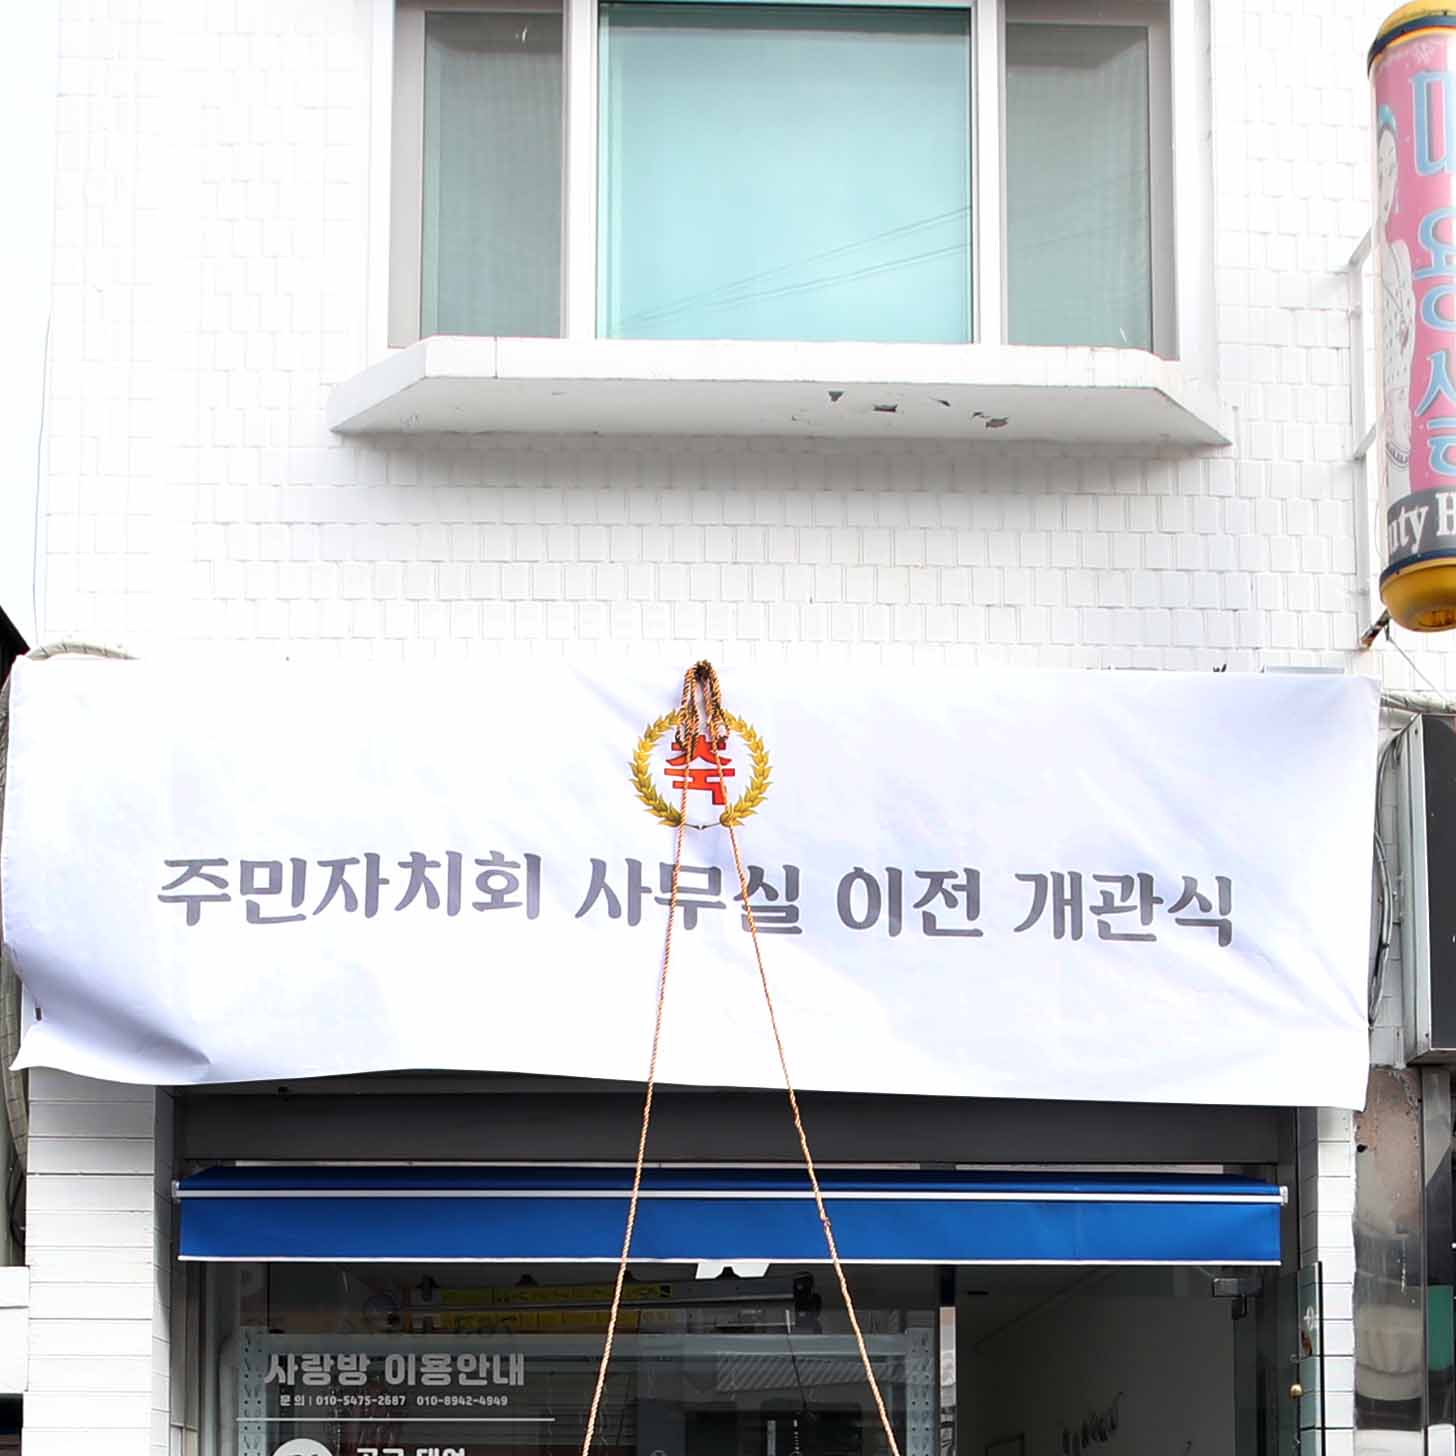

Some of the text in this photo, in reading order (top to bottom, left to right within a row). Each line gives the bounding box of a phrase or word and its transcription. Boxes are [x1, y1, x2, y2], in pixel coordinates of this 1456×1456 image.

[664, 734, 735, 805] 축
[157, 850, 1234, 947] 주민자치회 사무실 이전 개관식
[265, 1352, 525, 1387] 사랑방 이용안내
